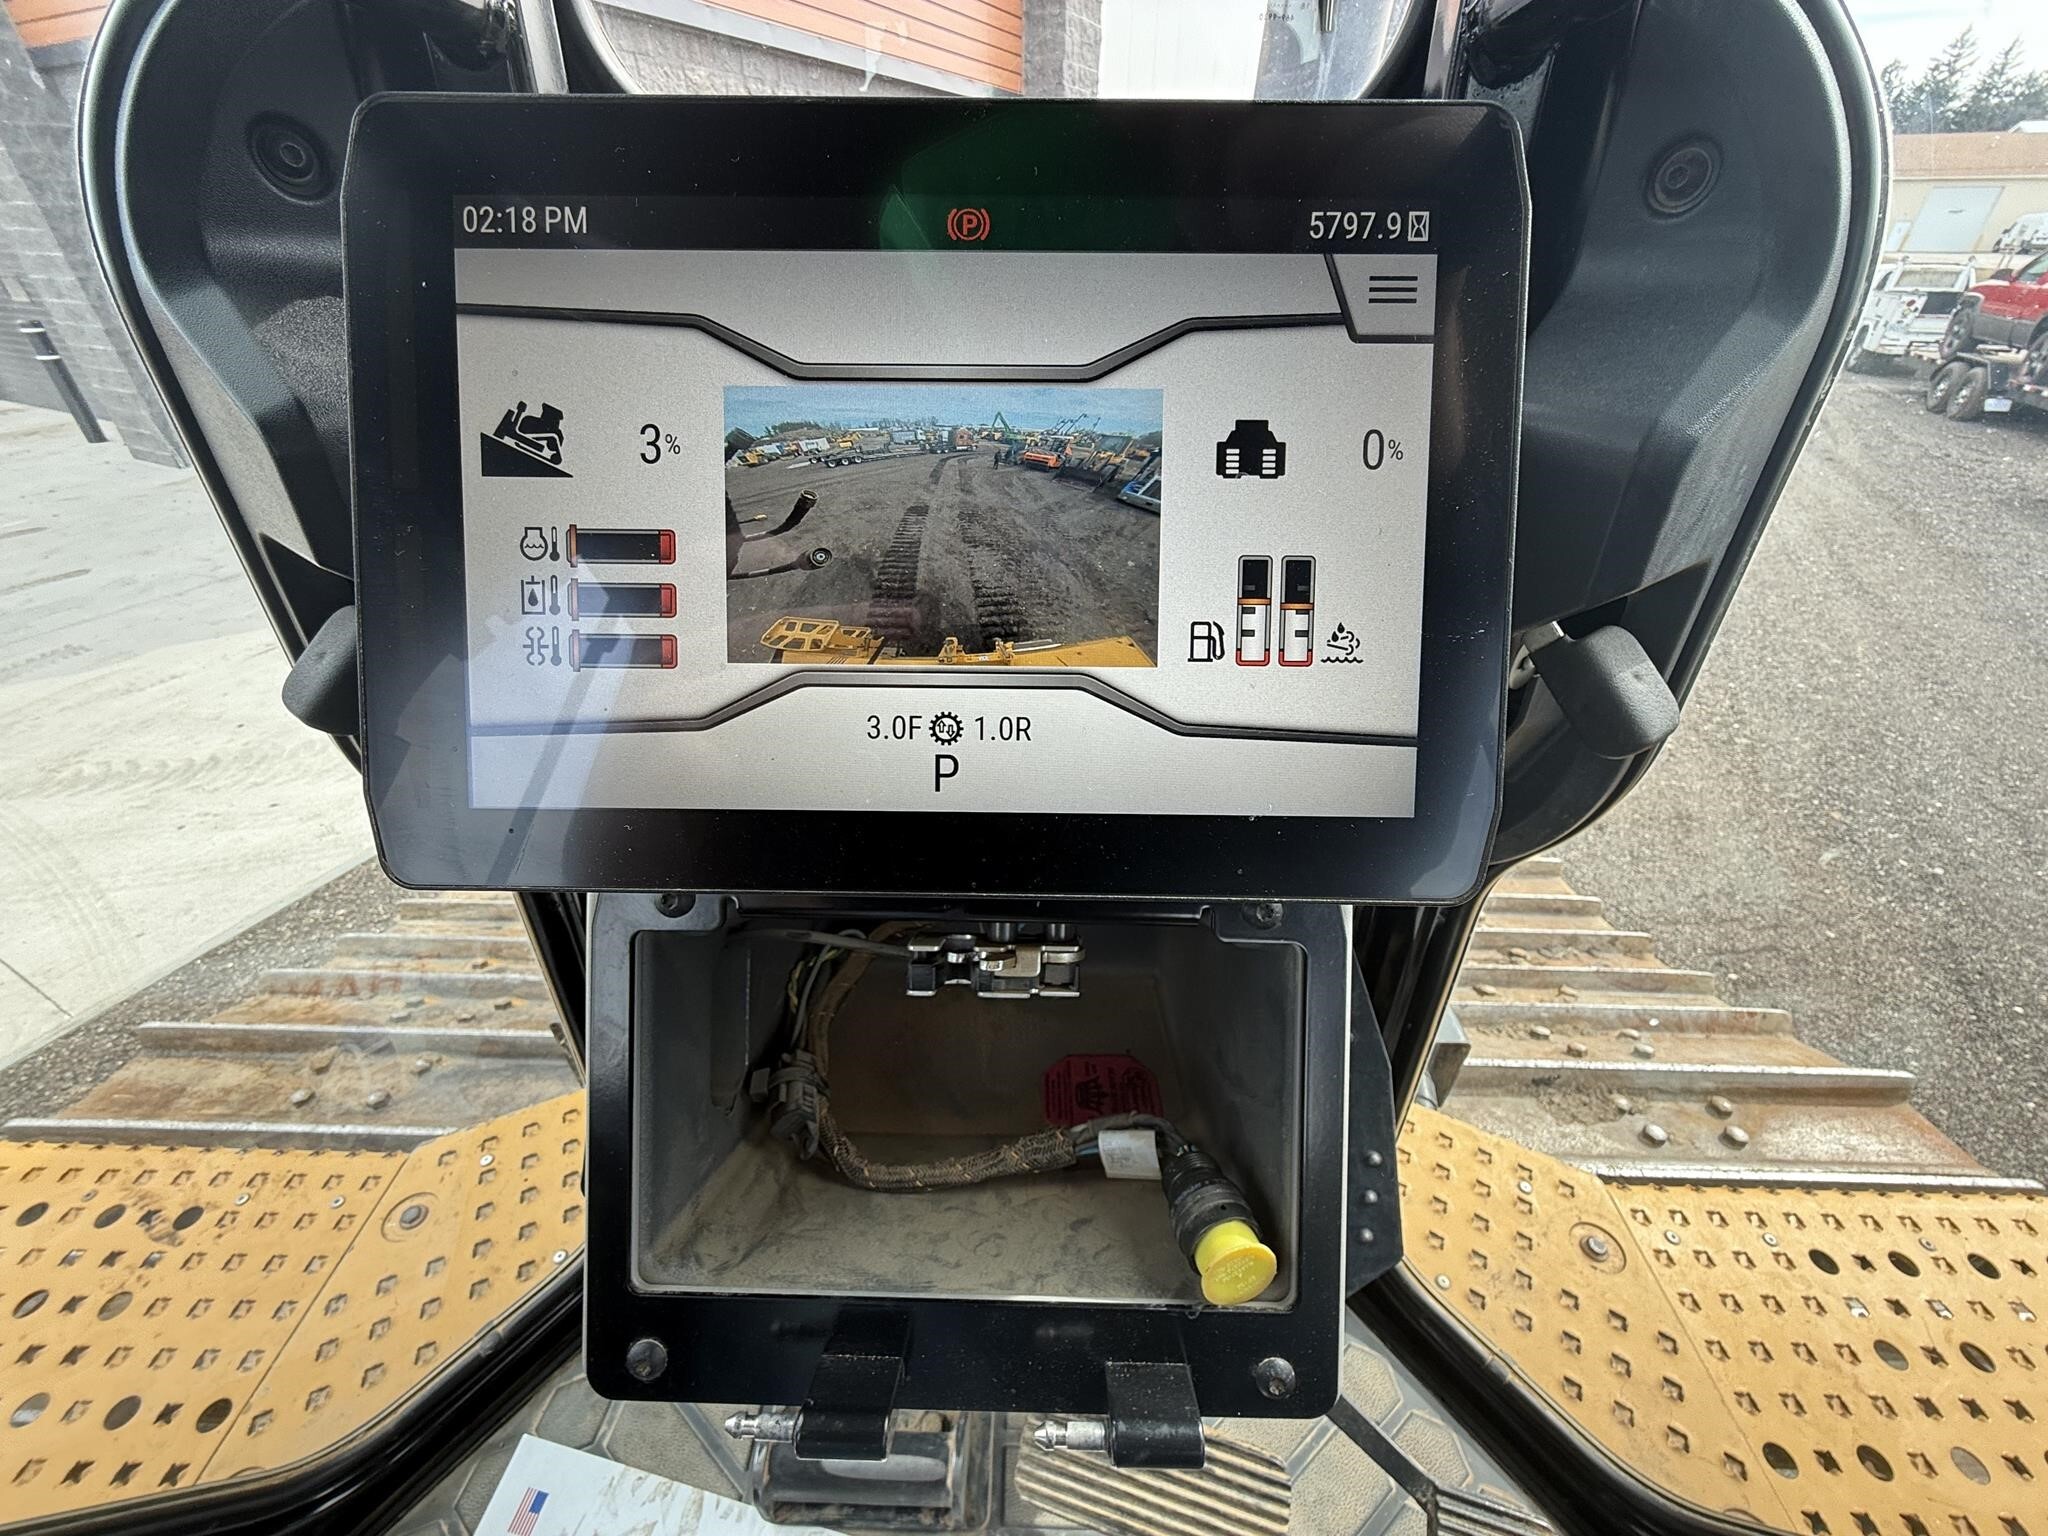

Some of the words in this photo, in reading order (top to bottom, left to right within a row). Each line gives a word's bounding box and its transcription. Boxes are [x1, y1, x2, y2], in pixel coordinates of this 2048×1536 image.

[463, 206, 536, 233] 02:18
[545, 206, 588, 234] PM
[1309, 211, 1402, 240] 5797.9
[867, 715, 922, 740] 3.0F
[975, 716, 1032, 741] 1.0R
[934, 754, 960, 793] P
